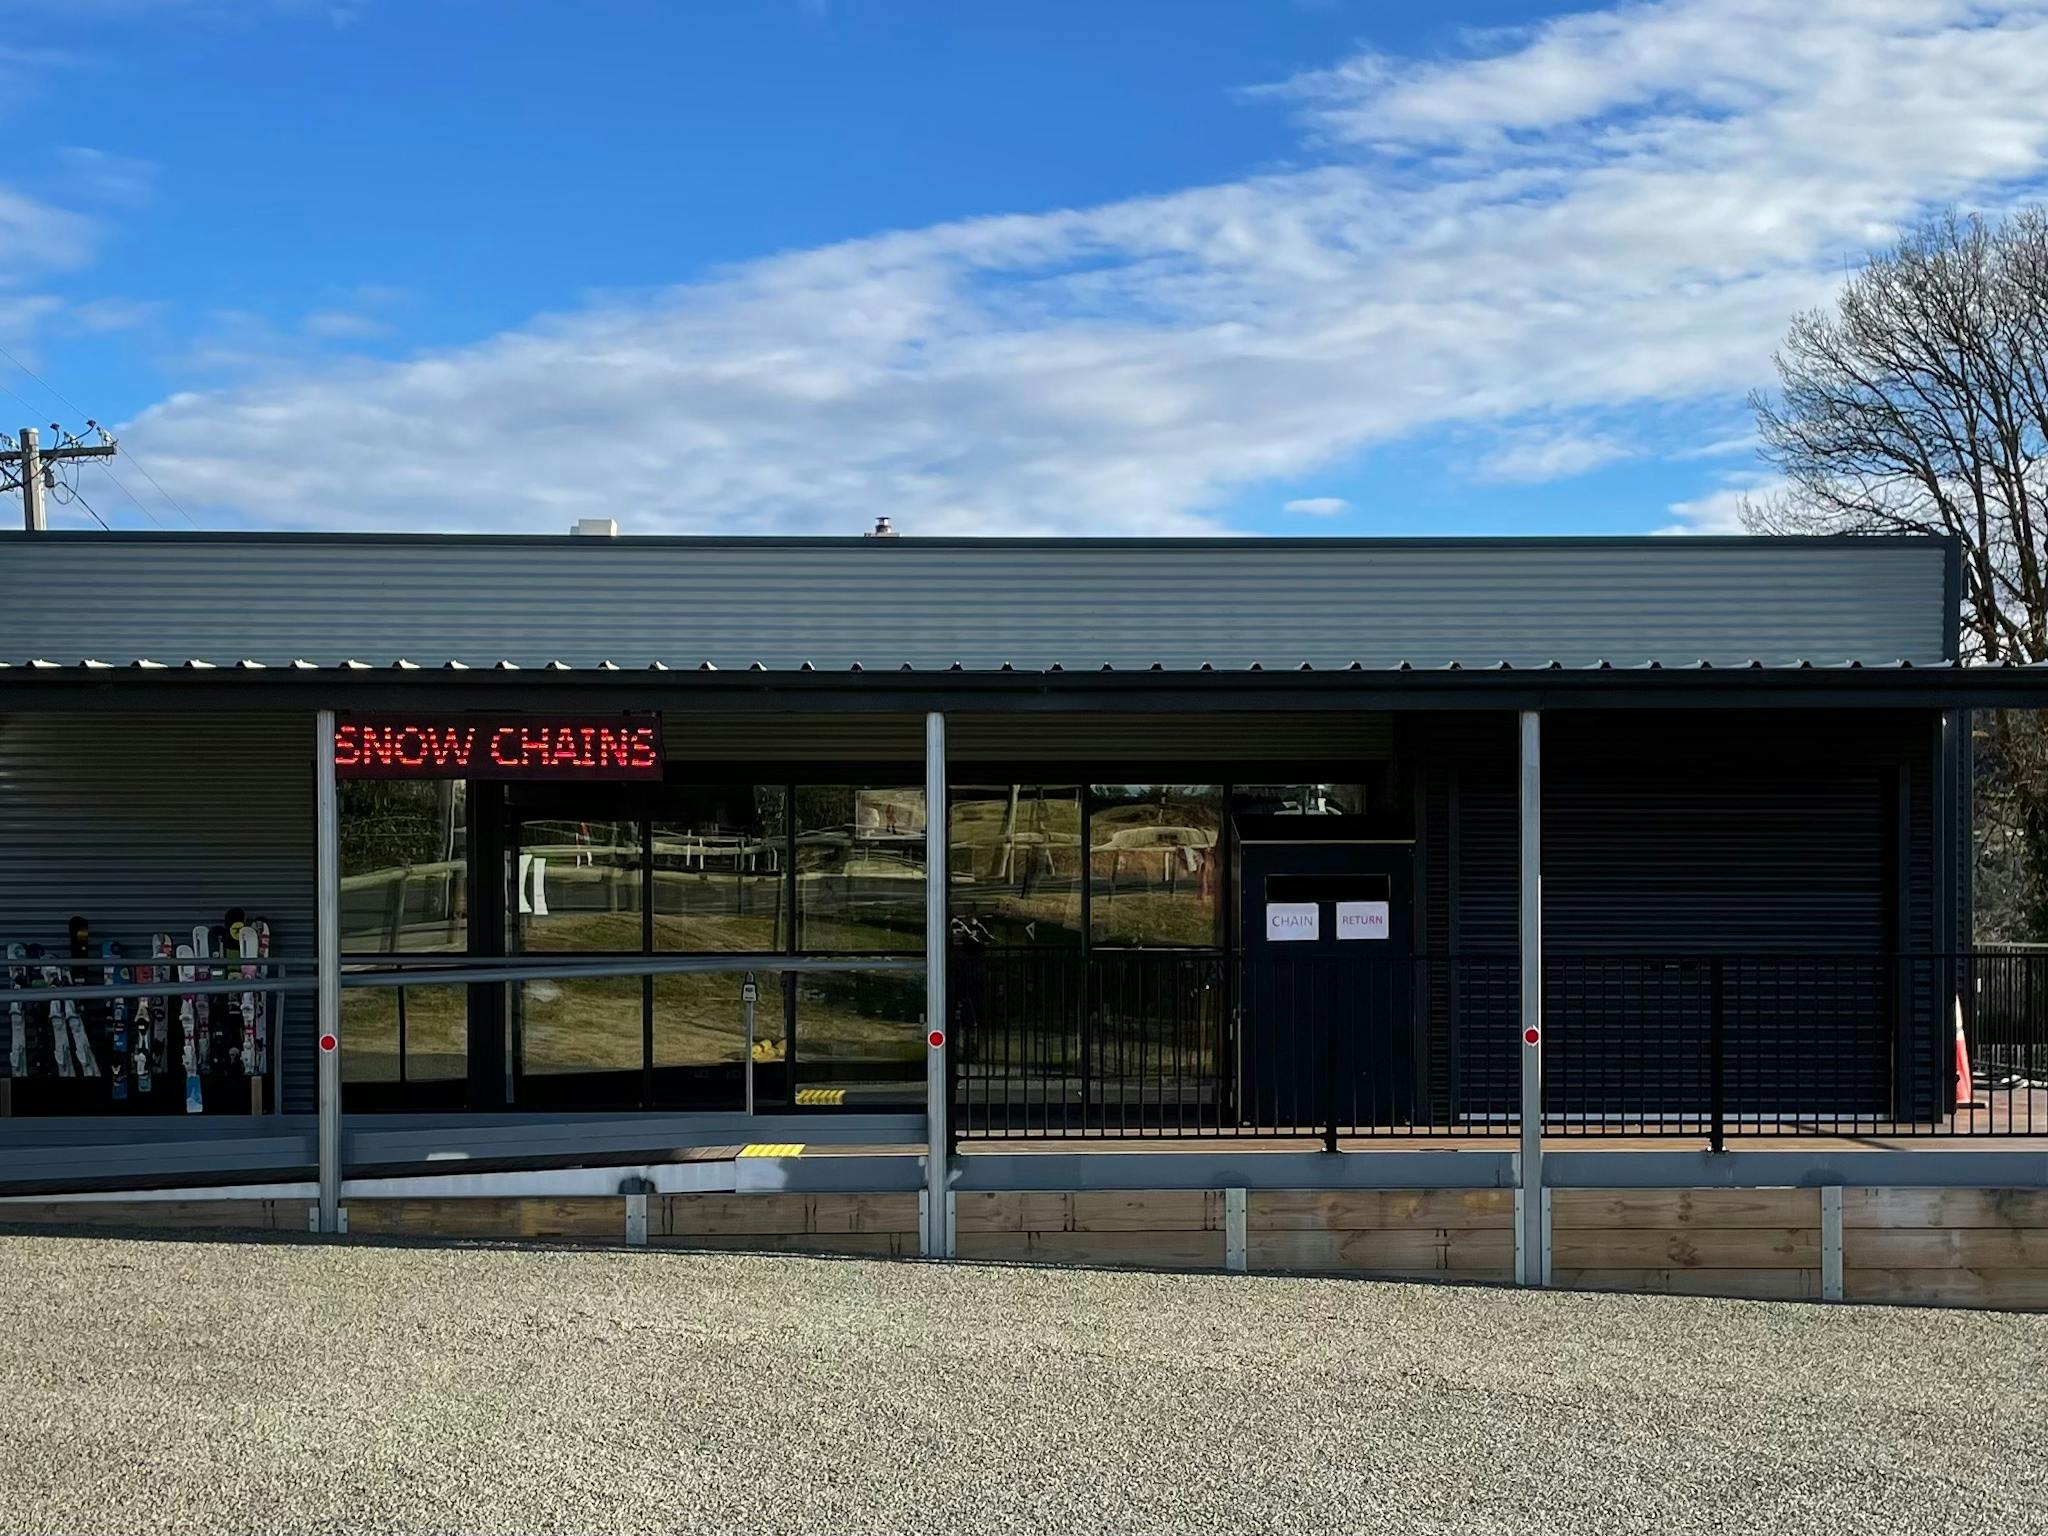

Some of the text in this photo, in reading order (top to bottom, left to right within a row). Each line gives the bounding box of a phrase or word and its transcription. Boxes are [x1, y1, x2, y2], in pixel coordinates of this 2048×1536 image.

[335, 727, 656, 766] SNOW CHAINS
[1271, 915, 1383, 928] CHAIN RETURN
